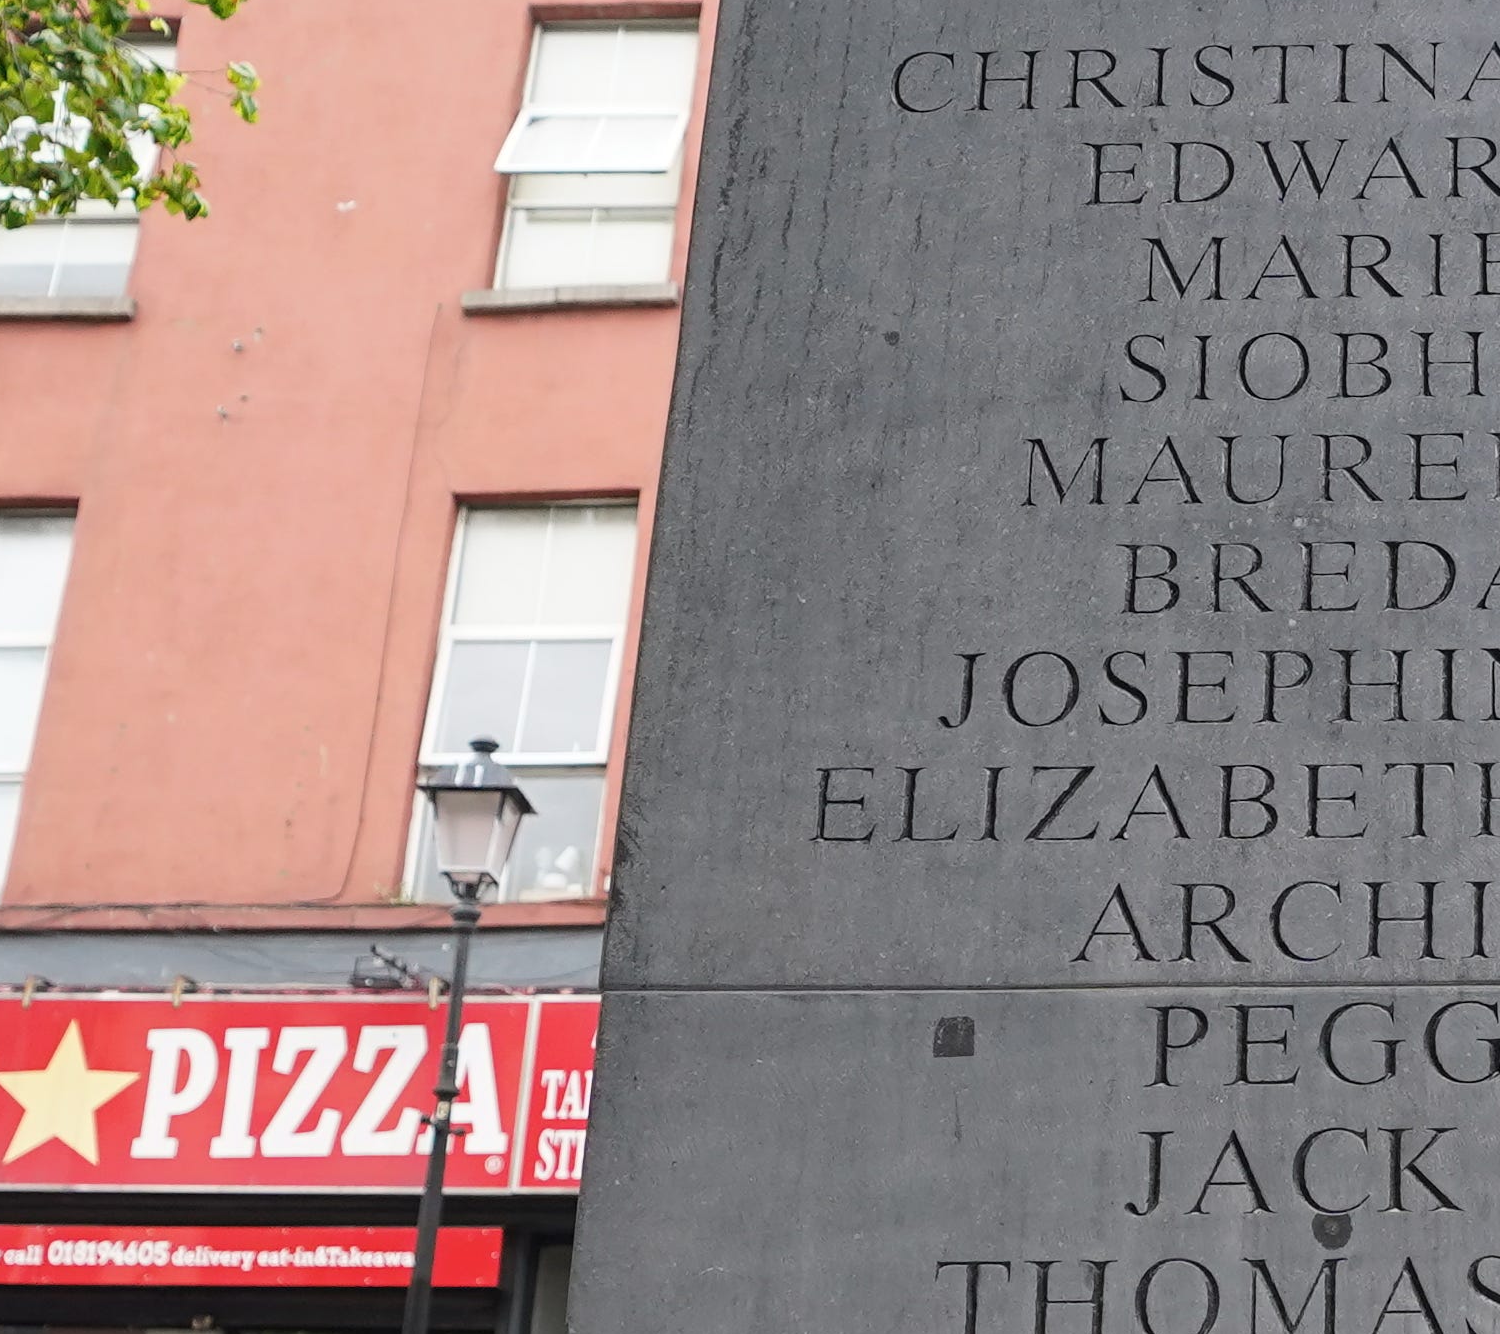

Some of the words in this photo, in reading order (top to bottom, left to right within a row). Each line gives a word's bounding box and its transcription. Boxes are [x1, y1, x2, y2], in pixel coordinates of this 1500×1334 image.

[130, 1022, 508, 1158] PIZZA
[1124, 1128, 1463, 1218] JACK
[3, 1244, 43, 1266] call
[47, 1240, 171, 1267] 018194605
[171, 1246, 255, 1271] delivery
